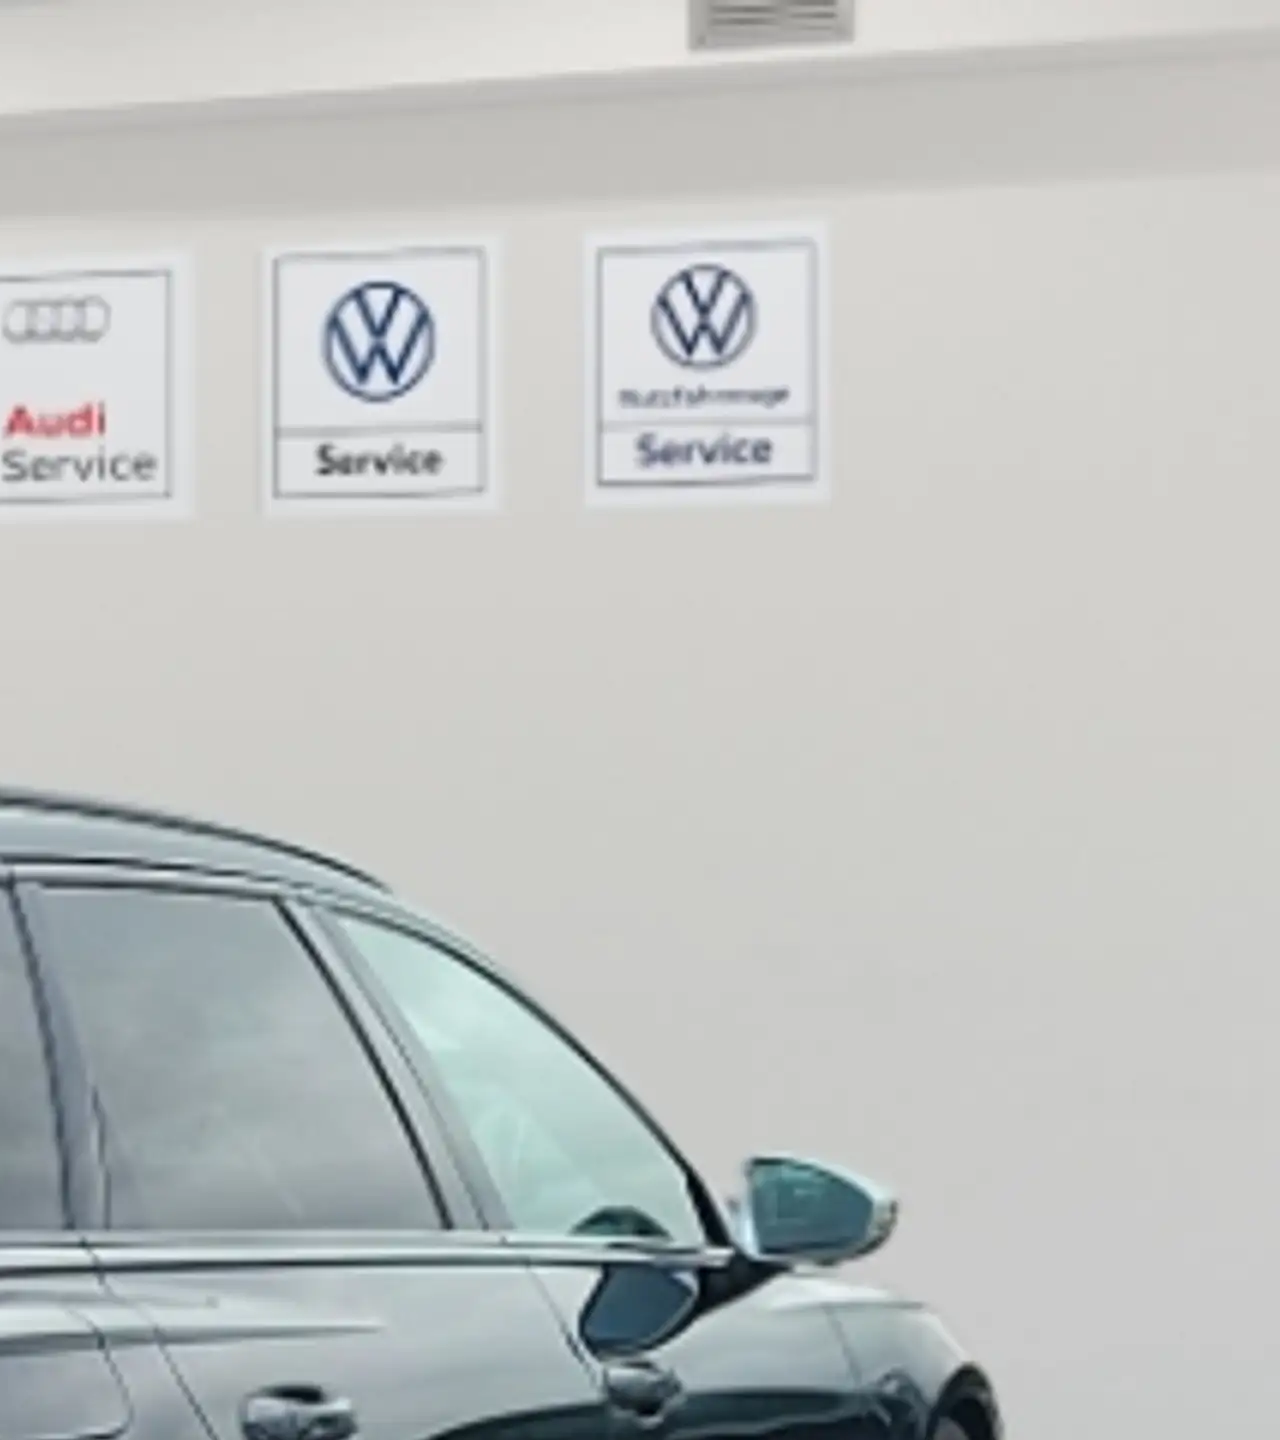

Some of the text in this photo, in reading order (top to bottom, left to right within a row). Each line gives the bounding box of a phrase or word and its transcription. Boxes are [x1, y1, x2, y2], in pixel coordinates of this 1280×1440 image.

[4, 402, 107, 438] Audi
[2, 446, 159, 483] Service
[315, 443, 445, 477] Service
[636, 432, 773, 468] Service
